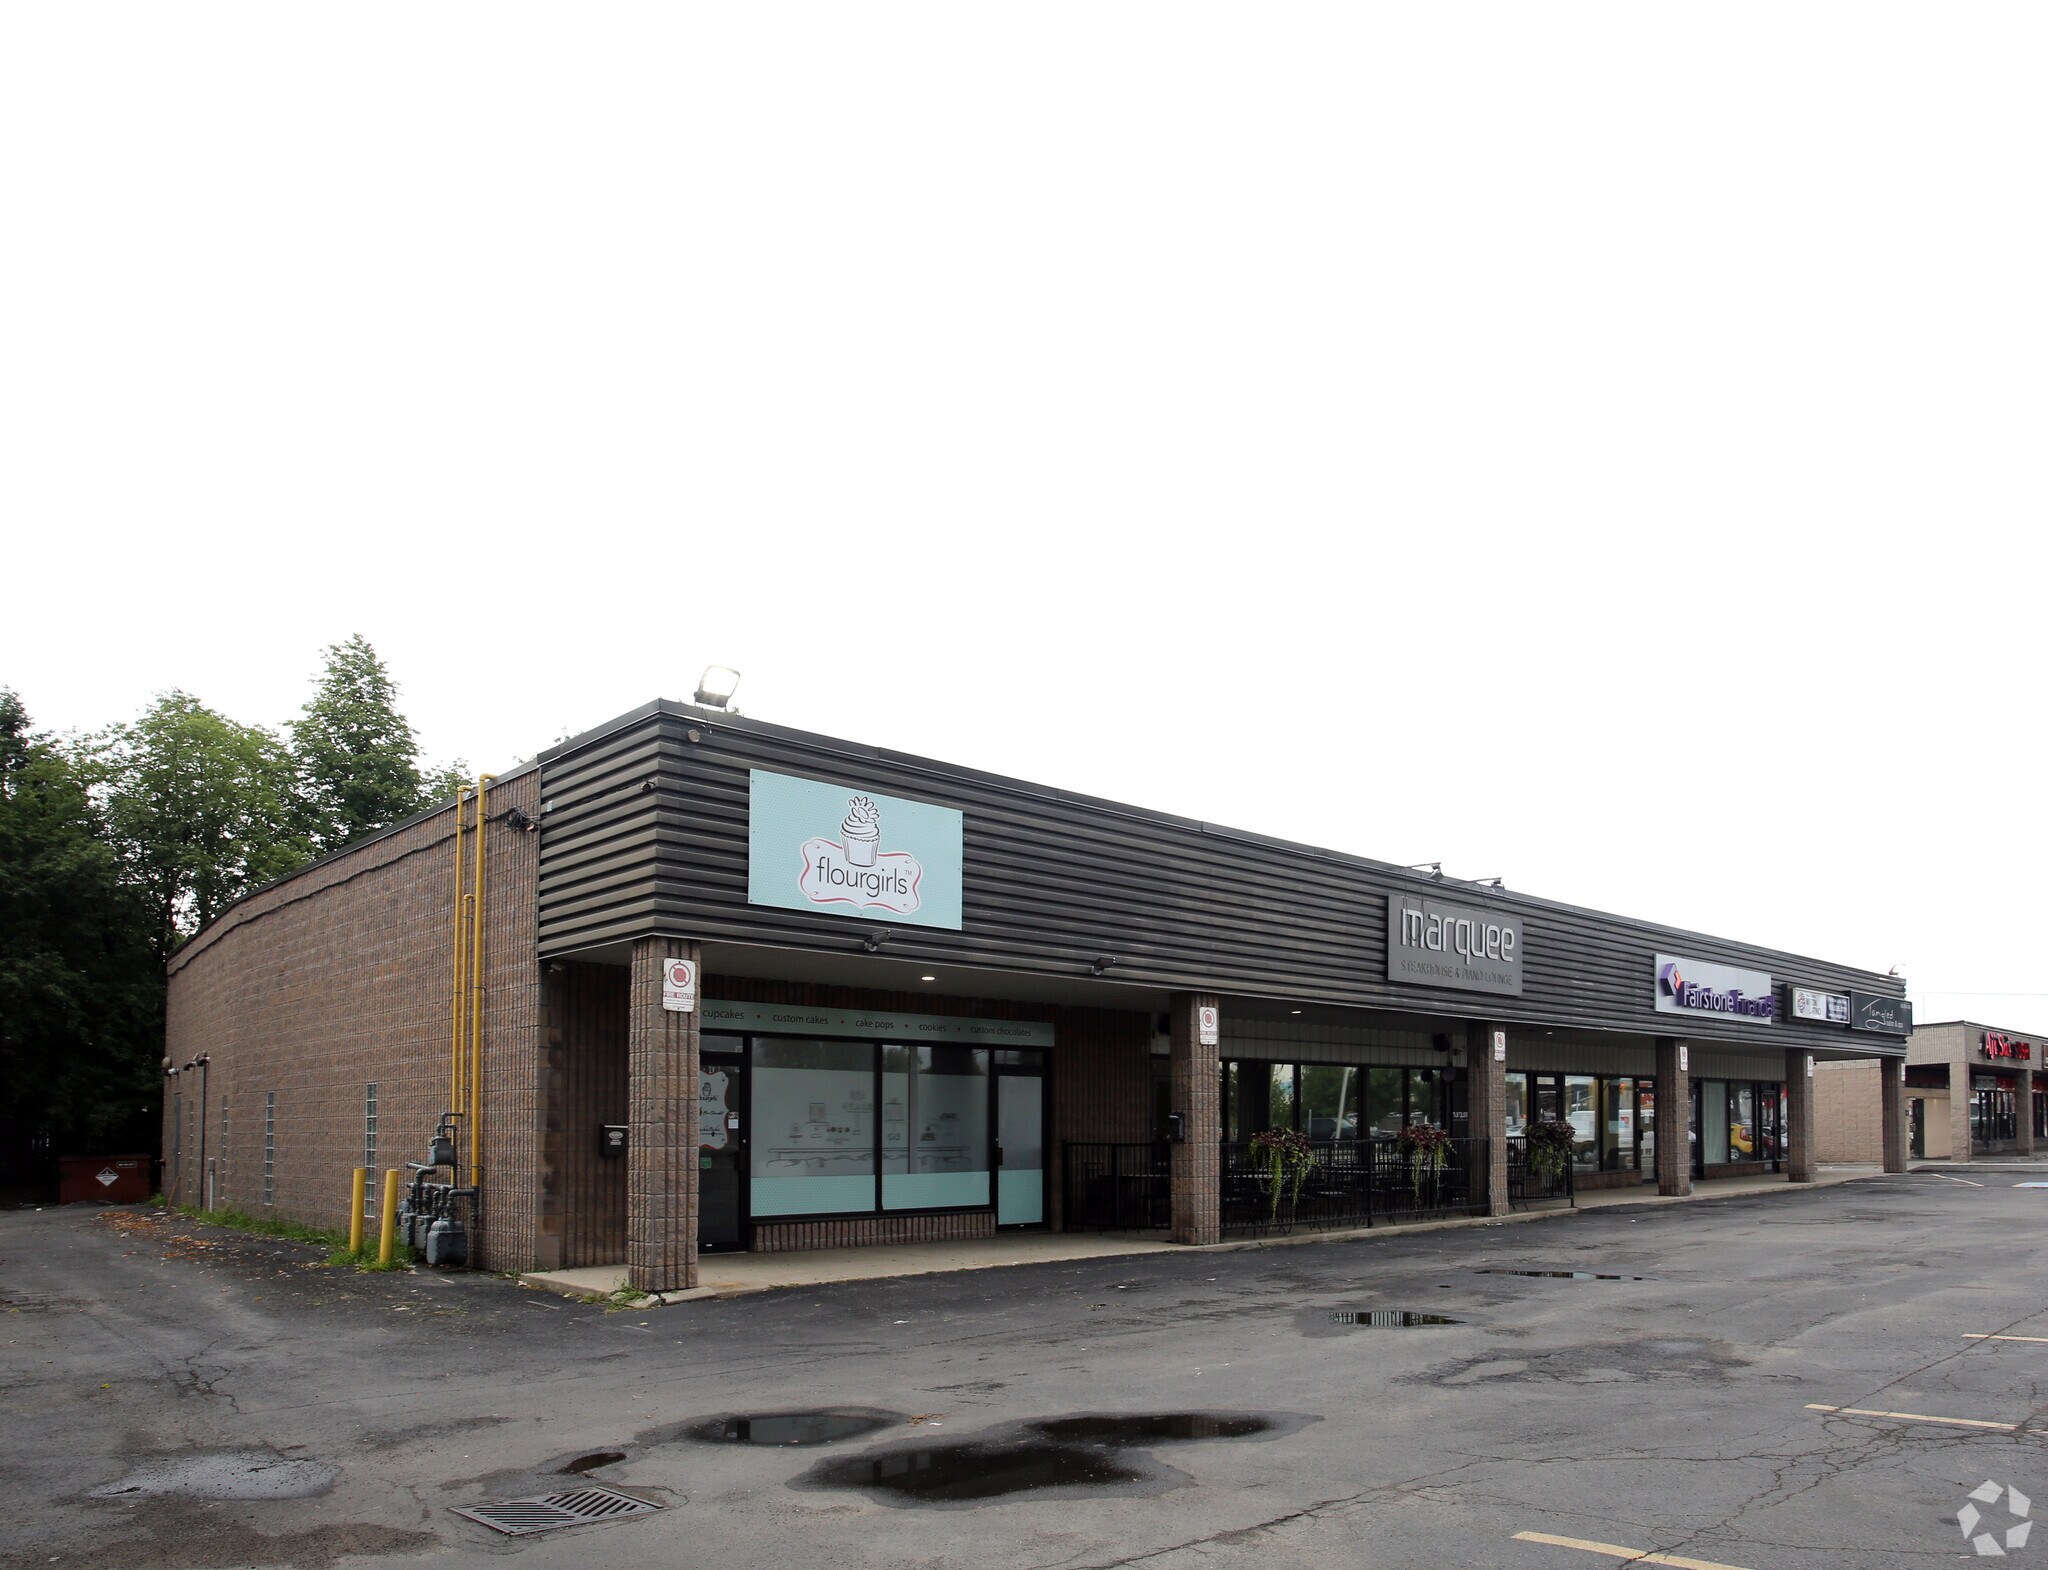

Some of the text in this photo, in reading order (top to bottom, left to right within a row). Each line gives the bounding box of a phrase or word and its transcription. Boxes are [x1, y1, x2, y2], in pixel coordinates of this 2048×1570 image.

[816, 856, 908, 898] flourgirls
[1401, 908, 1515, 965] marquee
[1401, 960, 1513, 986] STEAKHOUSE & PIANO LOUNGE
[1682, 981, 1734, 1012] Fairstone
[702, 1009, 1032, 1037] cupcakes custom cakes cake pops cookies custom chocolates
[1861, 997, 1894, 1029] Tangled
